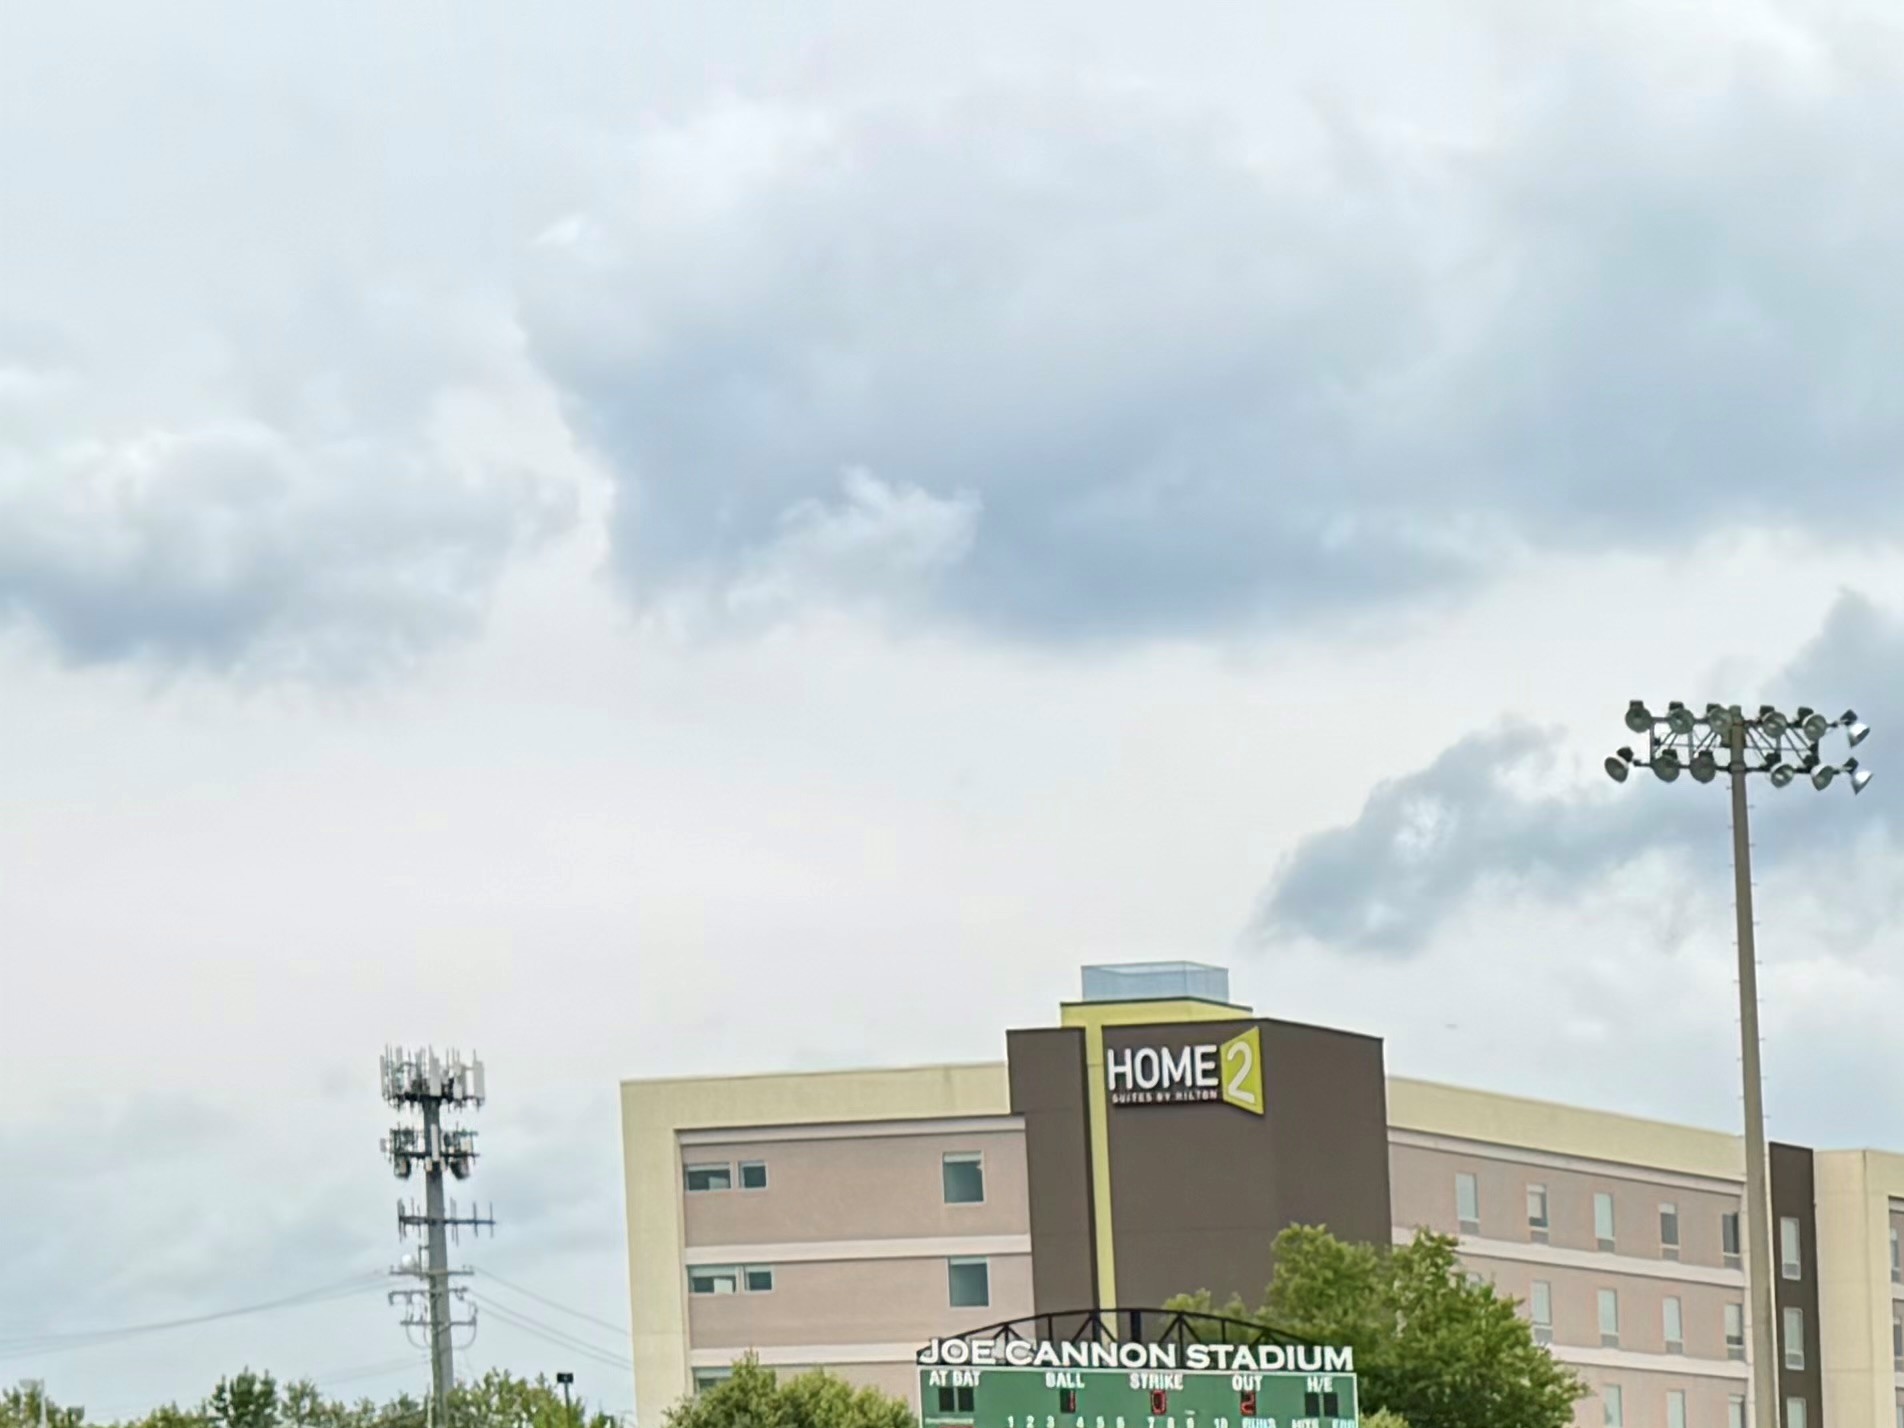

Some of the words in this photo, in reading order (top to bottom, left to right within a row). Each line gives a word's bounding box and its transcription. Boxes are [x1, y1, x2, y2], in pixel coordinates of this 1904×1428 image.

[1107, 1044, 1219, 1091] HOME
[1226, 1041, 1256, 1104] 2
[918, 1339, 997, 1365] JOE
[1005, 1340, 1177, 1369] CANNON
[1185, 1344, 1354, 1371] STADIUM
[929, 1371, 948, 1387] AT
[952, 1371, 981, 1387] BAT
[1045, 1372, 1086, 1389] BALL
[1129, 1373, 1184, 1391] STRIKE
[1231, 1375, 1264, 1391] OUT
[1240, 1391, 1256, 1416] 2
